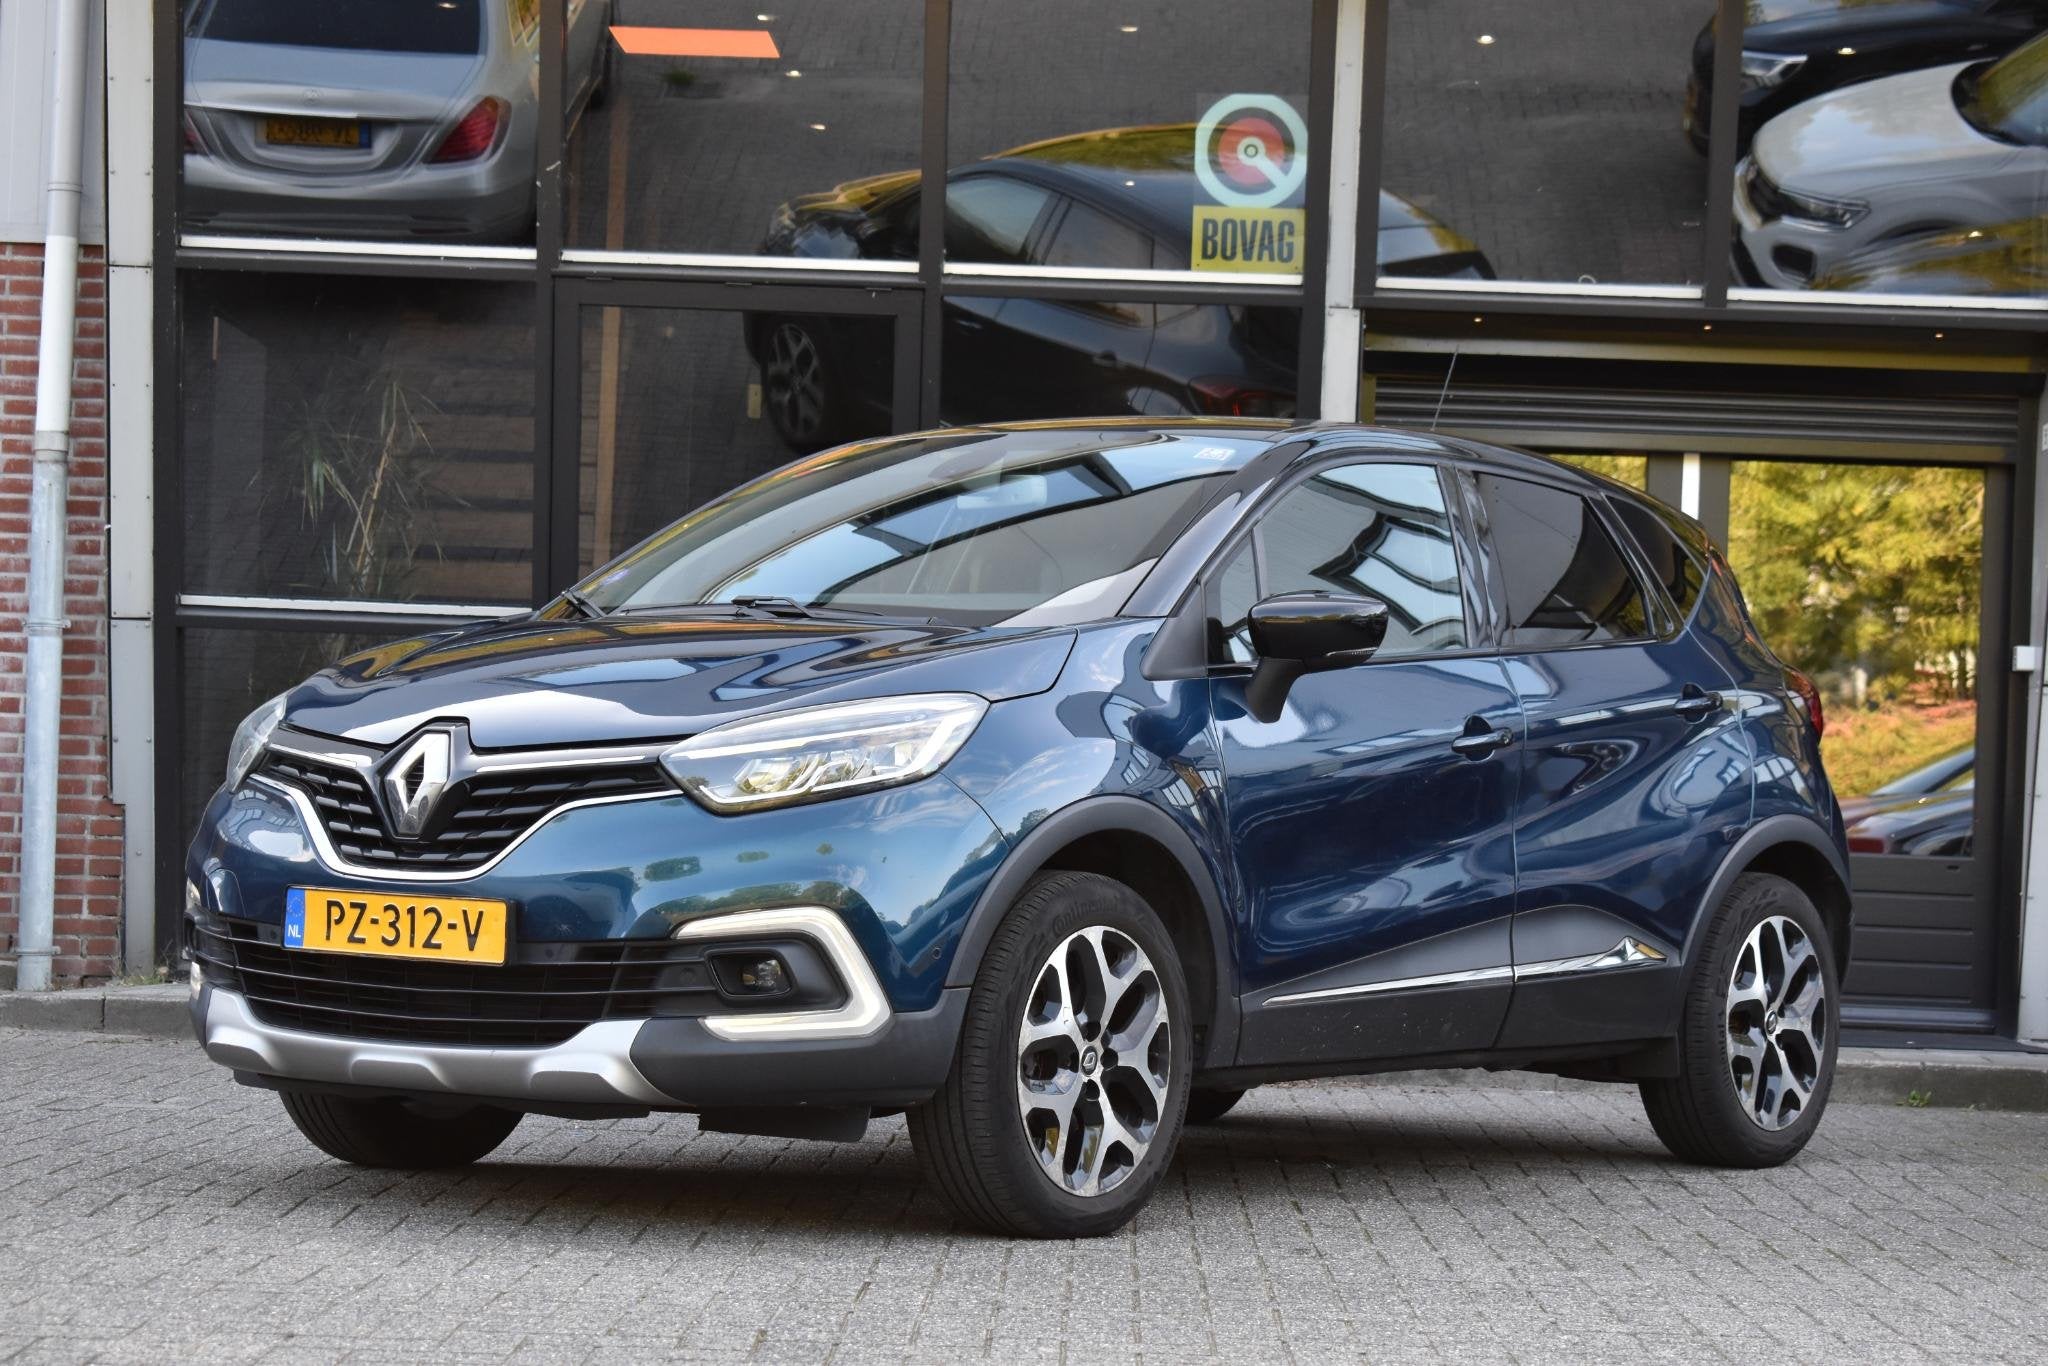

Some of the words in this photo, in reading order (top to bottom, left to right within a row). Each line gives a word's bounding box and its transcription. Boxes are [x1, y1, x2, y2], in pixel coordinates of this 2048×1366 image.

[1201, 218, 1295, 263] BOVAG
[288, 925, 301, 938] NL
[325, 900, 484, 951] PZ-312-V
